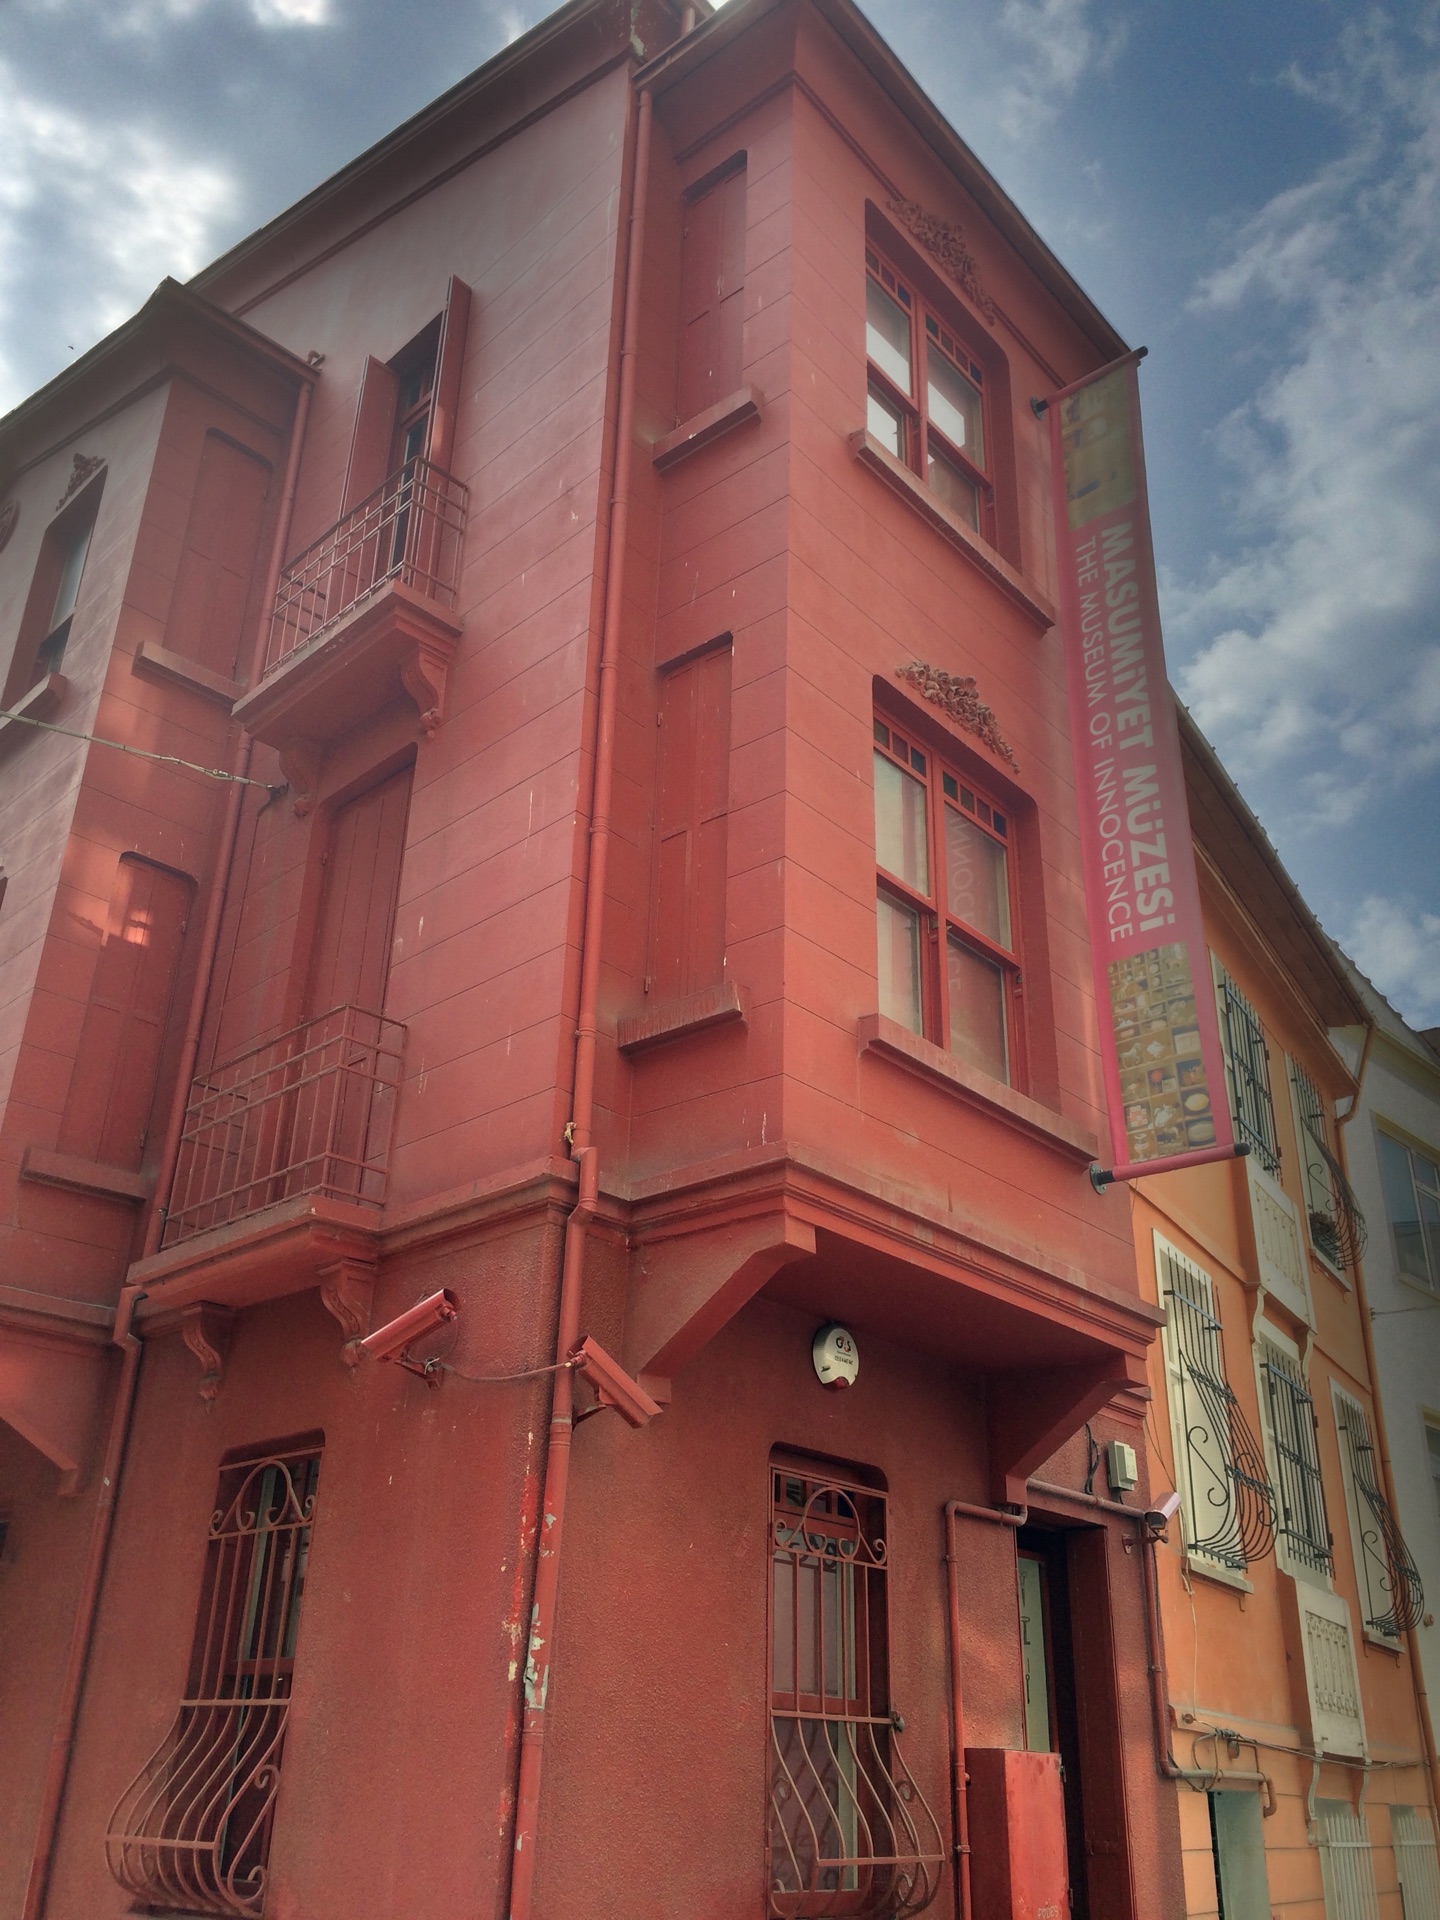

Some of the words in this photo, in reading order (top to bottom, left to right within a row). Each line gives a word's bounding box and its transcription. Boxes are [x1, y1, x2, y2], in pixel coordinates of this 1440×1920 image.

[1076, 536, 1098, 587] THE
[1080, 592, 1108, 708] MUSEUM
[1101, 522, 1154, 750] MASUMİYET
[1089, 712, 1112, 749] OF
[1093, 758, 1133, 942] INNOCENCE
[1122, 764, 1176, 932] MÜZESİ
